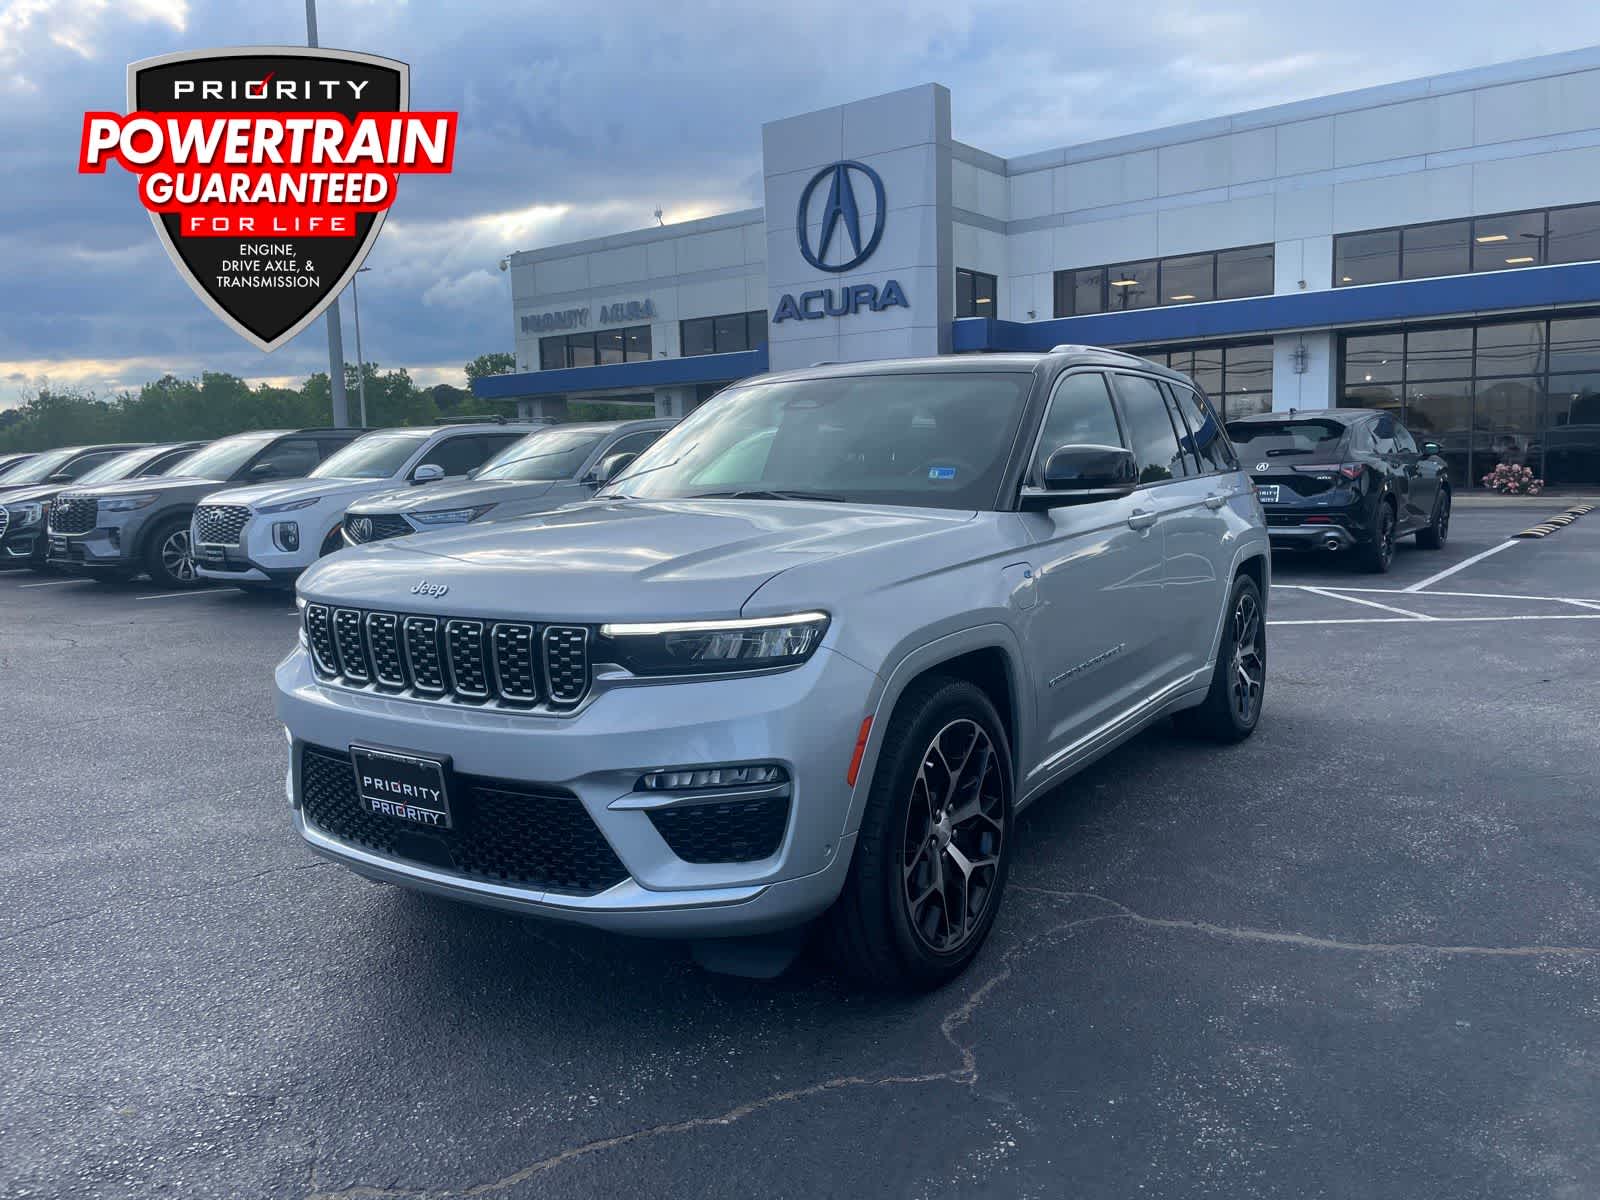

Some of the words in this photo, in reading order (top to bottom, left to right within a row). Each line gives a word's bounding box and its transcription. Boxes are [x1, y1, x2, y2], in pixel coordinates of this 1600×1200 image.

[772, 279, 910, 323] ACURA
[410, 580, 448, 598] Jeep
[363, 775, 440, 802] PRIORITY
[371, 800, 439, 825] PRIORITY
